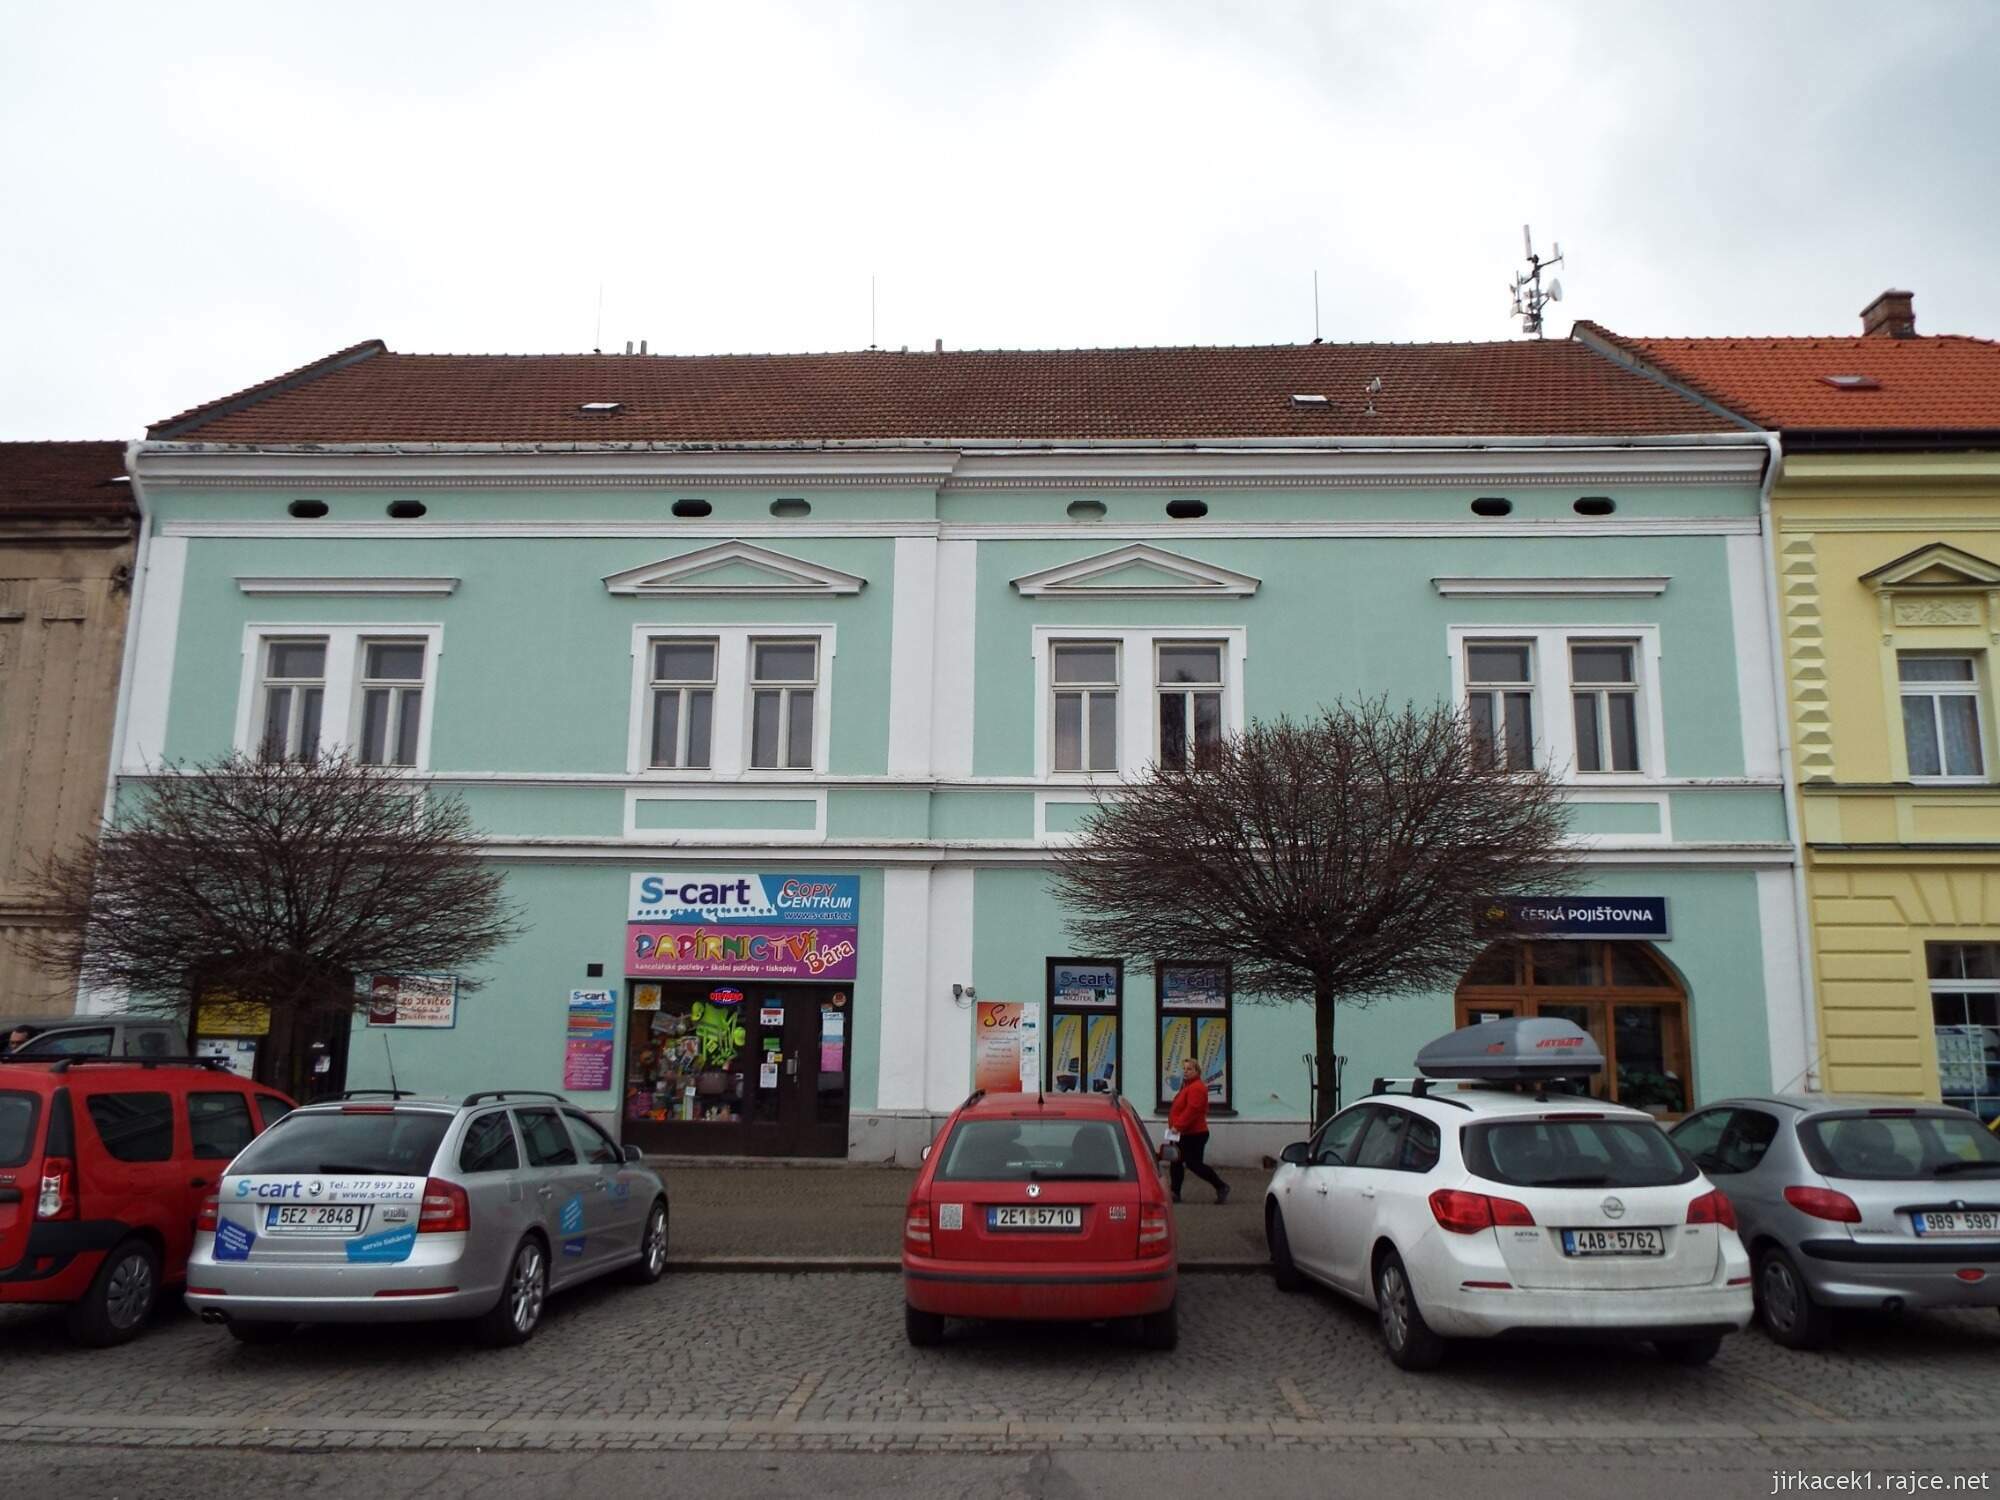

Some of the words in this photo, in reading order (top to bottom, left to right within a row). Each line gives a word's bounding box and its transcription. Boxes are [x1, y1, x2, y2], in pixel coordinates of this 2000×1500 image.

[640, 876, 751, 905] S-cart
[783, 879, 836, 898] COPY
[777, 889, 852, 909] CENTRUM
[784, 911, 852, 920] www.s-cart.cz
[1520, 906, 1565, 921] ČESKÁ
[1568, 905, 1653, 922] POJIŠŤOVNA
[634, 927, 817, 961] PAPÍRNICTVÍ
[804, 940, 854, 974] Bára
[634, 962, 676, 971] kancelářské
[677, 963, 704, 973] potřeby
[710, 963, 731, 972] školní
[732, 964, 760, 974] potřeby
[765, 964, 797, 974] tiskopisy
[1059, 971, 1114, 988] S-cart
[573, 991, 607, 1001] S-cart
[235, 1179, 302, 1198] S-cart
[329, 1181, 349, 1190] Tel.:
[352, 1181, 370, 1190] 777
[374, 1181, 392, 1190] 997
[396, 1181, 415, 1190] 320
[342, 1191, 414, 1200] www.s-cart.cz
[281, 1208, 307, 1224] 5E2
[317, 1208, 354, 1224] 2848
[1000, 1208, 1027, 1225] 2E1
[1038, 1208, 1074, 1225] 5710
[1926, 1214, 1954, 1230] 9B9
[1964, 1213, 1999, 1230] 5987
[1578, 1232, 1606, 1249] 4AB
[1617, 1231, 1657, 1249] 5762
